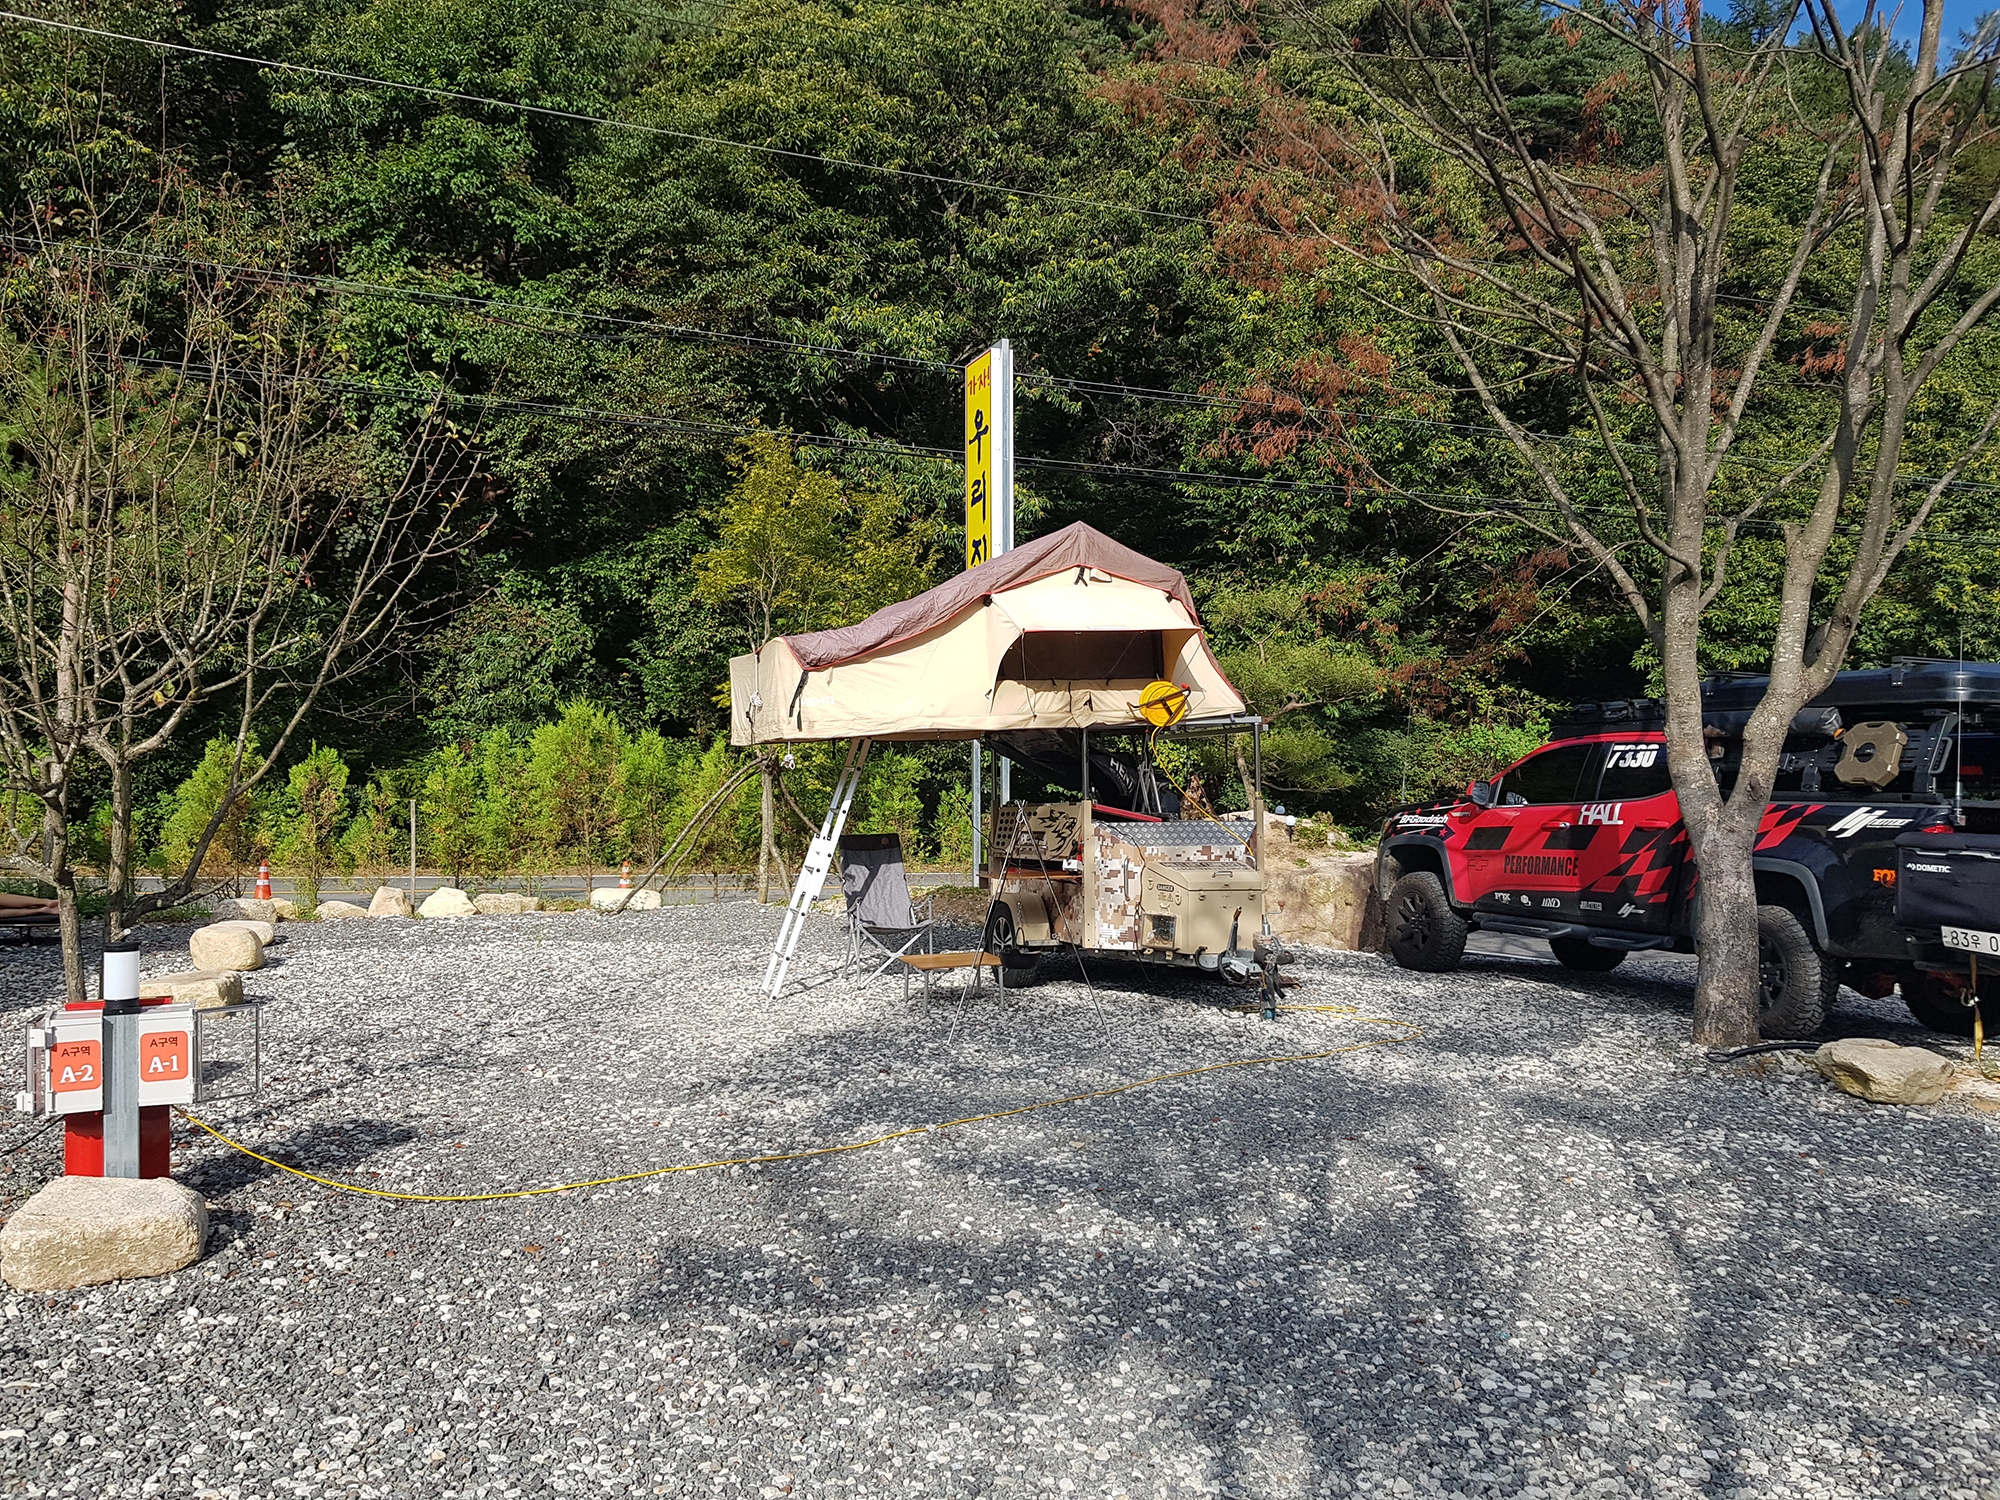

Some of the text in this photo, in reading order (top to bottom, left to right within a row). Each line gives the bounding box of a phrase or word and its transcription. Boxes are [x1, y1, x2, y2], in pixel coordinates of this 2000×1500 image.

[967, 366, 990, 395] 가자!
[1607, 744, 1659, 768] 7330
[1399, 814, 1449, 824] BFGoodrich
[1578, 803, 1624, 825] HALL
[1504, 855, 1579, 876] PERFORMANCE
[1916, 864, 1953, 873] DOMETIC
[1950, 930, 1981, 949] 83우
[149, 1036, 178, 1047] A구역
[61, 1045, 91, 1058] A구역
[60, 1064, 94, 1083] A-2
[148, 1055, 179, 1073] A-1
